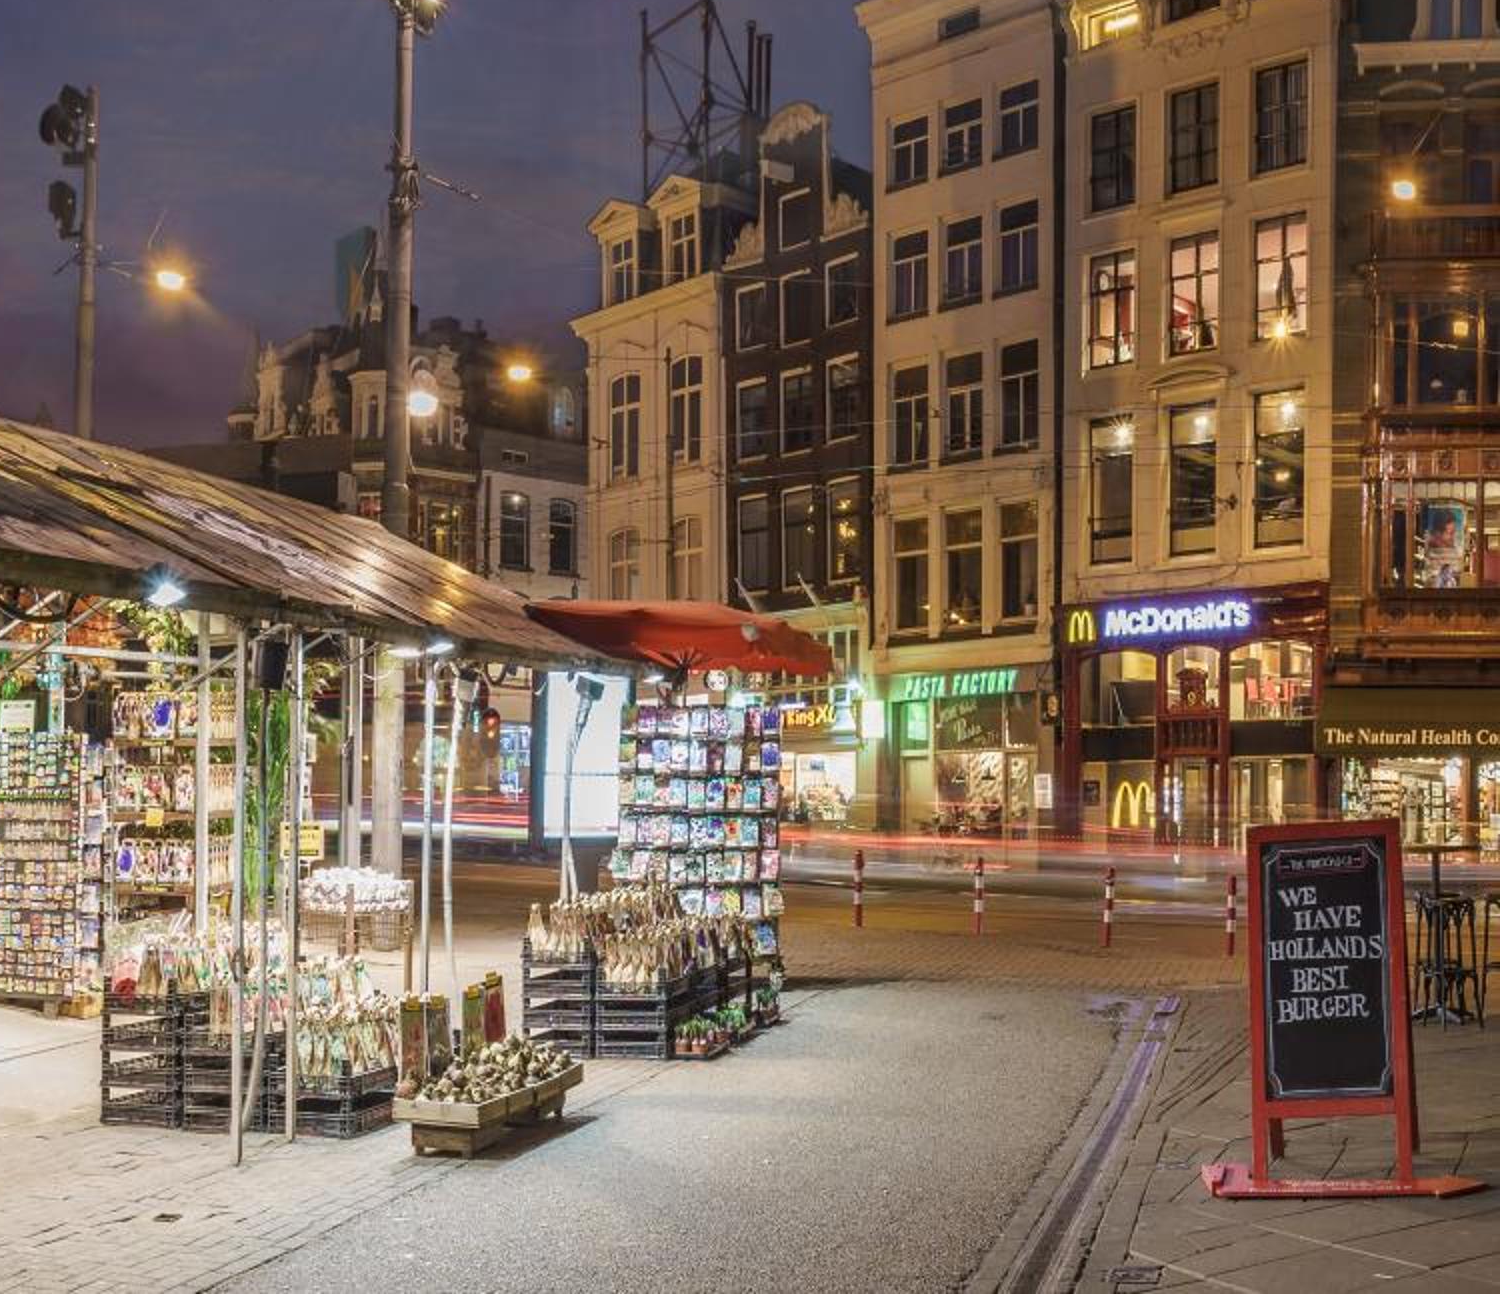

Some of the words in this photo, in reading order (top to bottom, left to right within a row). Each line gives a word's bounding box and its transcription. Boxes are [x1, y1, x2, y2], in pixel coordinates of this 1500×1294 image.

[1104, 602, 1252, 637] McDonald's
[904, 675, 946, 699] PASTA
[952, 669, 1019, 696] FACTORY
[1324, 728, 1354, 745] The
[1357, 728, 1417, 745] Natural
[1421, 729, 1472, 745] Health
[1476, 729, 1500, 745] Co
[1277, 887, 1317, 908] WE
[1293, 905, 1363, 931] HAVE
[1269, 934, 1383, 961] HOLLANDS
[1290, 965, 1349, 993] BEST
[1276, 993, 1370, 1024] BURGER
